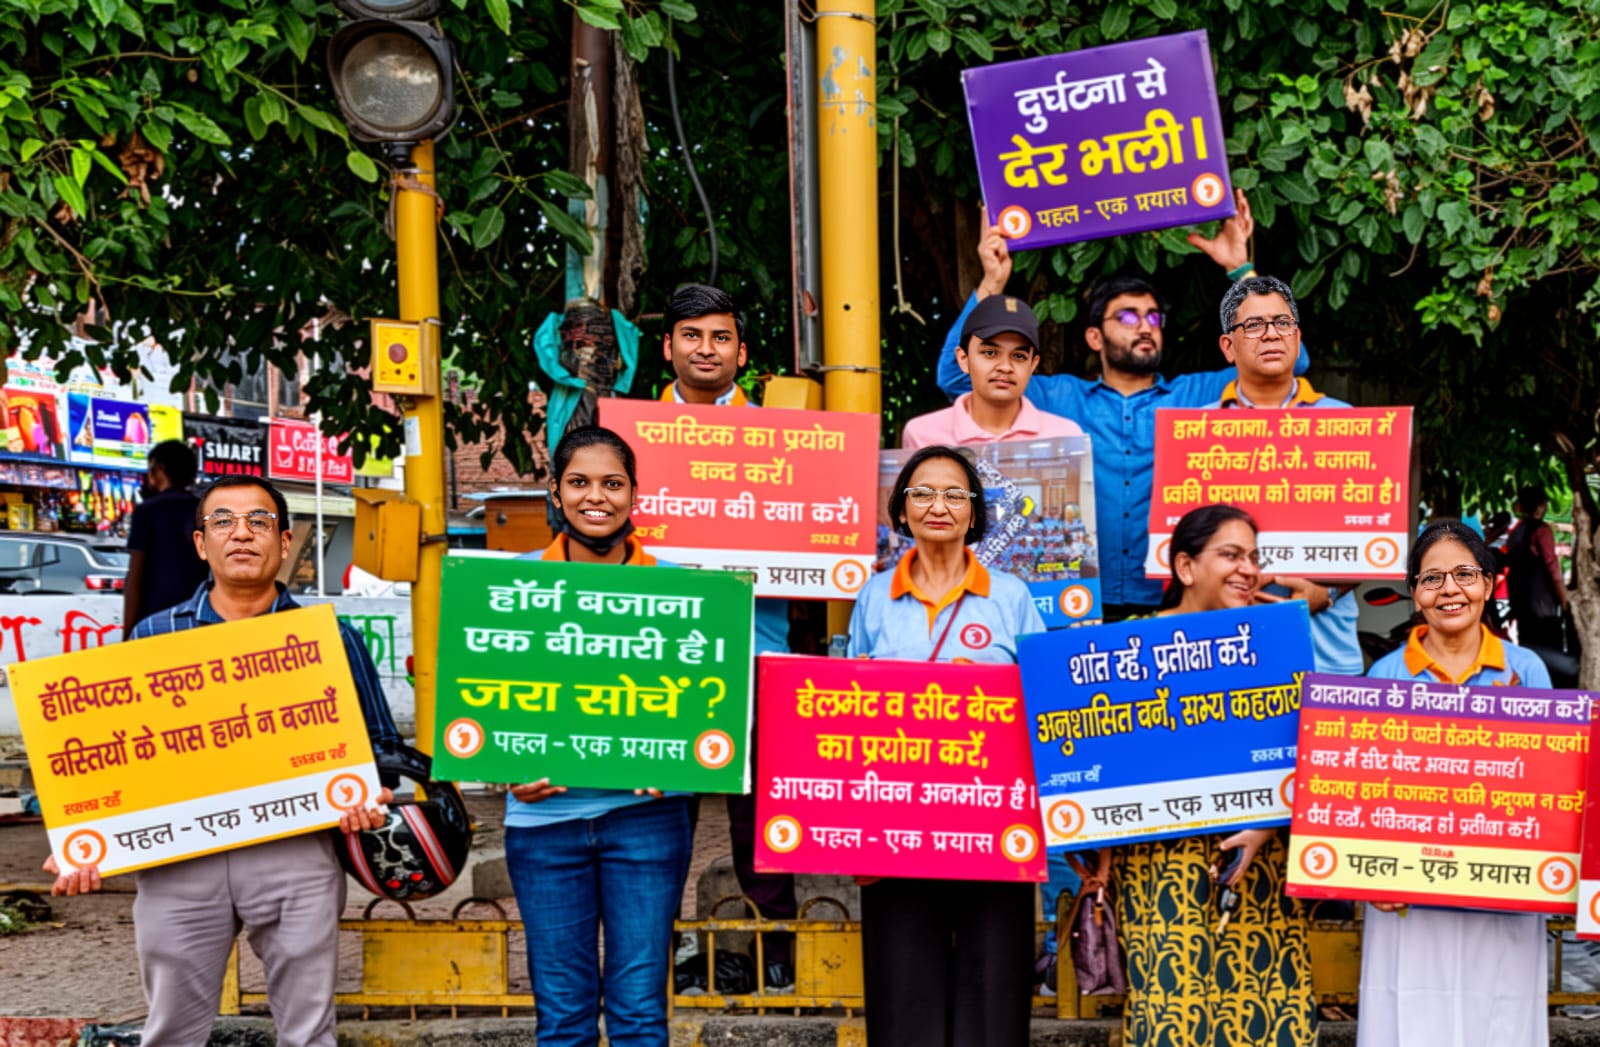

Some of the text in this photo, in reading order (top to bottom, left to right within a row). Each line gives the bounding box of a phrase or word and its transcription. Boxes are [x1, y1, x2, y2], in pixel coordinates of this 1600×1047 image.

[1014, 57, 1167, 134] दुर्घटना से
[999, 134, 1068, 188] देर
[1037, 205, 1079, 228] पहल
[1095, 197, 1128, 221] एक
[1134, 187, 1188, 212] प्रयास
[205, 442, 262, 463] SMART
[636, 415, 845, 452] प्लास्टिक का प्रयोग
[632, 487, 716, 518] र्यावरण
[724, 492, 755, 520] की
[1266, 478, 1290, 504] को
[1304, 545, 1358, 562] प्रयास
[768, 566, 826, 586] प्रयास
[488, 579, 703, 619] हॉर्न बजाना
[463, 626, 535, 653] एक
[545, 622, 667, 660] बीमारी
[1070, 643, 1111, 685] शांत
[1152, 631, 1213, 681] प्रतीक्षा
[145, 663, 204, 708] स्कूल
[209, 658, 227, 685] व
[231, 634, 322, 682] आवासीय
[456, 678, 561, 713] जरा
[574, 674, 691, 718] सोचें
[796, 679, 880, 718] हेलमेट
[886, 691, 904, 717] व
[912, 684, 961, 721] सीट
[1386, 683, 1407, 708] के
[1471, 694, 1495, 714] का
[131, 726, 157, 760] के
[161, 724, 206, 755] पास
[209, 703, 252, 747] हार्न
[256, 710, 276, 734] न
[1037, 693, 1133, 756] अनुशासित
[1180, 692, 1226, 725] सभ्य
[493, 731, 548, 755] पहल
[570, 734, 613, 760] एक
[620, 737, 687, 761] प्रयास
[816, 733, 853, 760] का
[861, 728, 931, 766] प्रयोग
[1343, 746, 1359, 768] में
[769, 776, 843, 802] आपका
[850, 770, 913, 804] जीवन
[919, 777, 1004, 808] अनमोल
[1091, 802, 1143, 826] पहल
[1163, 795, 1202, 820] एक
[1211, 787, 1274, 812] प्रयास
[1540, 794, 1553, 810] न
[114, 822, 174, 853] पहल
[196, 808, 242, 838] एक
[249, 791, 320, 825] प्रयास
[810, 826, 862, 848] पहल
[884, 829, 922, 853] एक
[931, 831, 994, 853] प्रयास
[1347, 853, 1398, 877] पहल
[1420, 858, 1458, 882] एक
[1468, 862, 1532, 885] प्रयास
